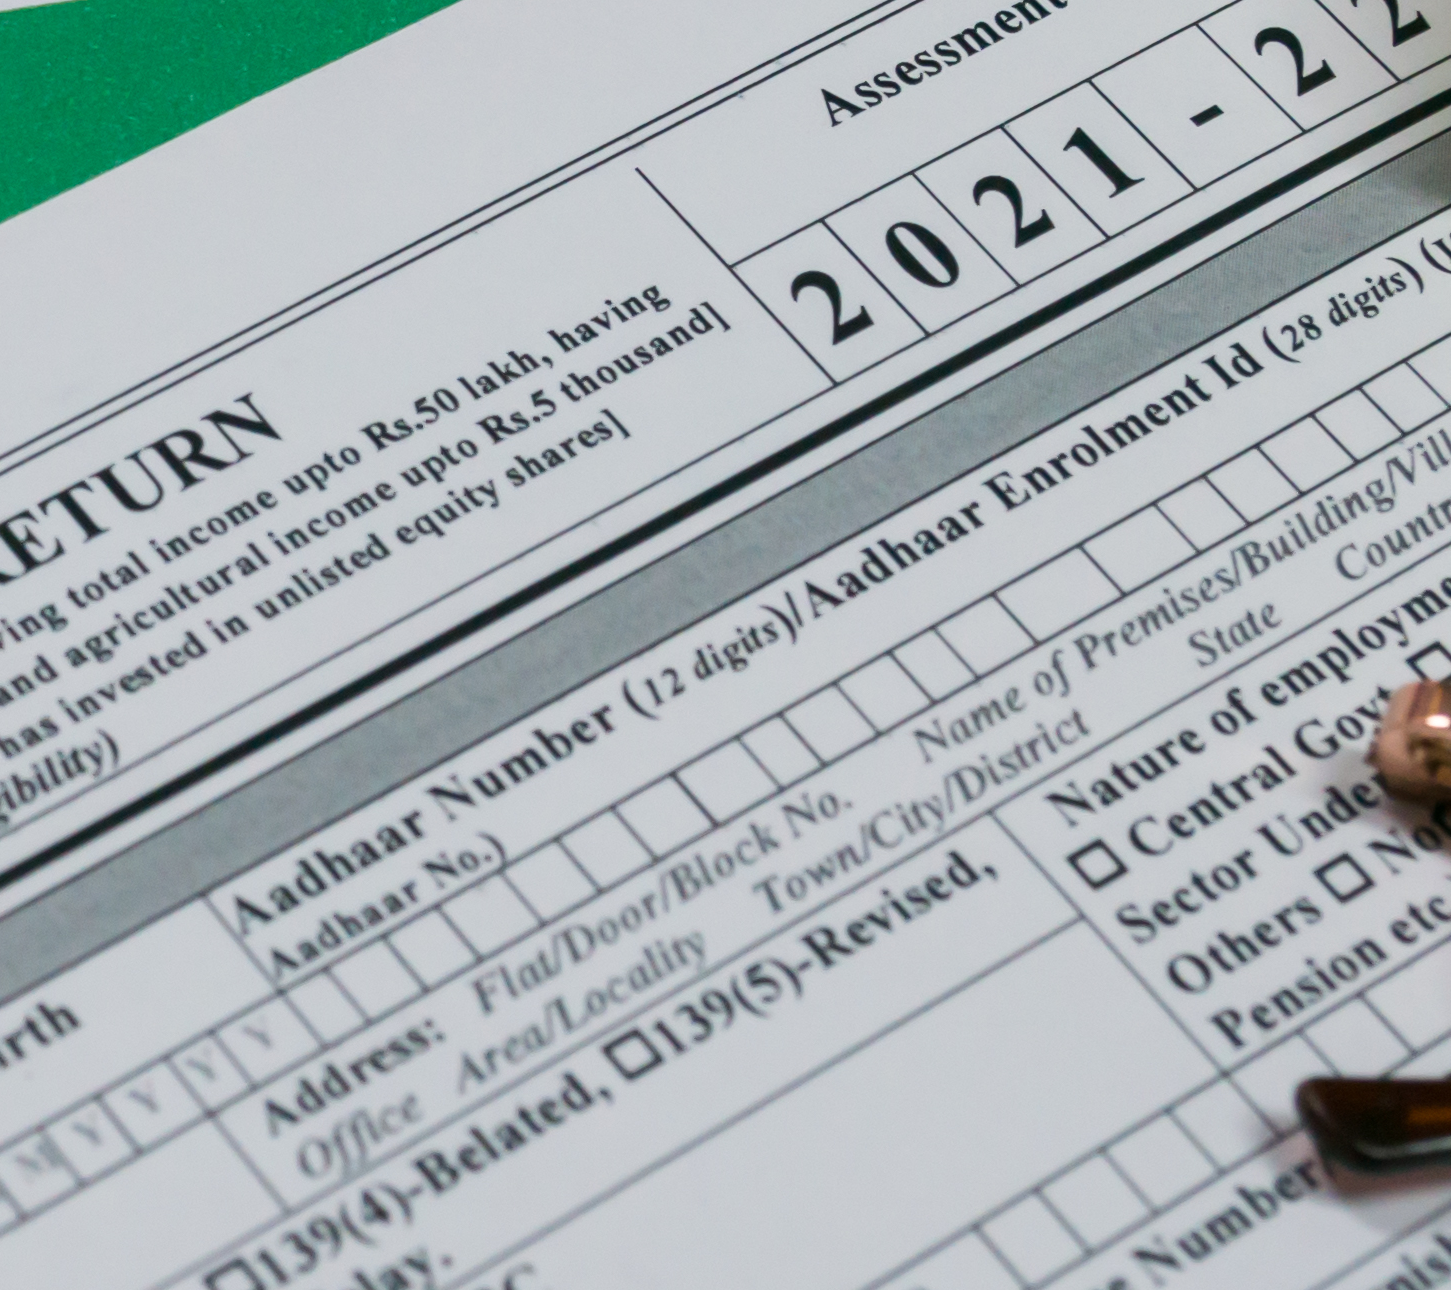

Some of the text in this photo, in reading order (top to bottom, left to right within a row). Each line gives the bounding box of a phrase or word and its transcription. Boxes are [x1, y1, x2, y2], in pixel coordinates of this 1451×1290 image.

[54, 627, 211, 726] invested
[201, 611, 253, 647] in
[250, 529, 394, 623] unlisted
[391, 475, 502, 548] equity
[501, 404, 634, 490] shares]
[60, 538, 273, 671] agricultural
[263, 479, 399, 559] income
[396, 435, 482, 490] upto
[471, 385, 560, 448] Rs.5
[556, 297, 734, 405] thousand]
[63, 547, 154, 612] total
[145, 487, 281, 567] income
[278, 443, 364, 498] upto
[356, 384, 463, 455] Rs.50
[453, 346, 556, 403] lakh,
[543, 281, 674, 356] having
[231, 807, 426, 938] Aadhaar
[423, 701, 617, 823] Number
[618, 664, 688, 722] (12
[690, 497, 987, 683] digits)/Aadhaar
[978, 371, 1215, 514] Enrolment
[1198, 338, 1267, 392] Id
[1258, 310, 1325, 366] (28
[1324, 253, 1427, 330] digits)
[261, 1015, 447, 1138] Address:
[467, 819, 782, 1017] Flat/Door/Block
[777, 789, 855, 840] No.
[909, 683, 1027, 766] Name
[1029, 645, 1073, 700] of
[266, 829, 524, 984] Aadhaar No.)
[293, 1091, 422, 1180] Office
[455, 929, 708, 1096] Area/Locality
[748, 705, 1093, 917] Town/City/District
[1184, 599, 1285, 671] State
[1041, 726, 1208, 830] Nature
[1206, 683, 1261, 739] of
[1112, 846, 1260, 947] Sector
[1124, 741, 1299, 859] Central
[253, 1067, 615, 1288] 139(4)-Belated,
[649, 846, 1001, 1057] 139(5)-Revised,
[1163, 893, 1325, 996] Others
[1206, 935, 1402, 1063] Pension
